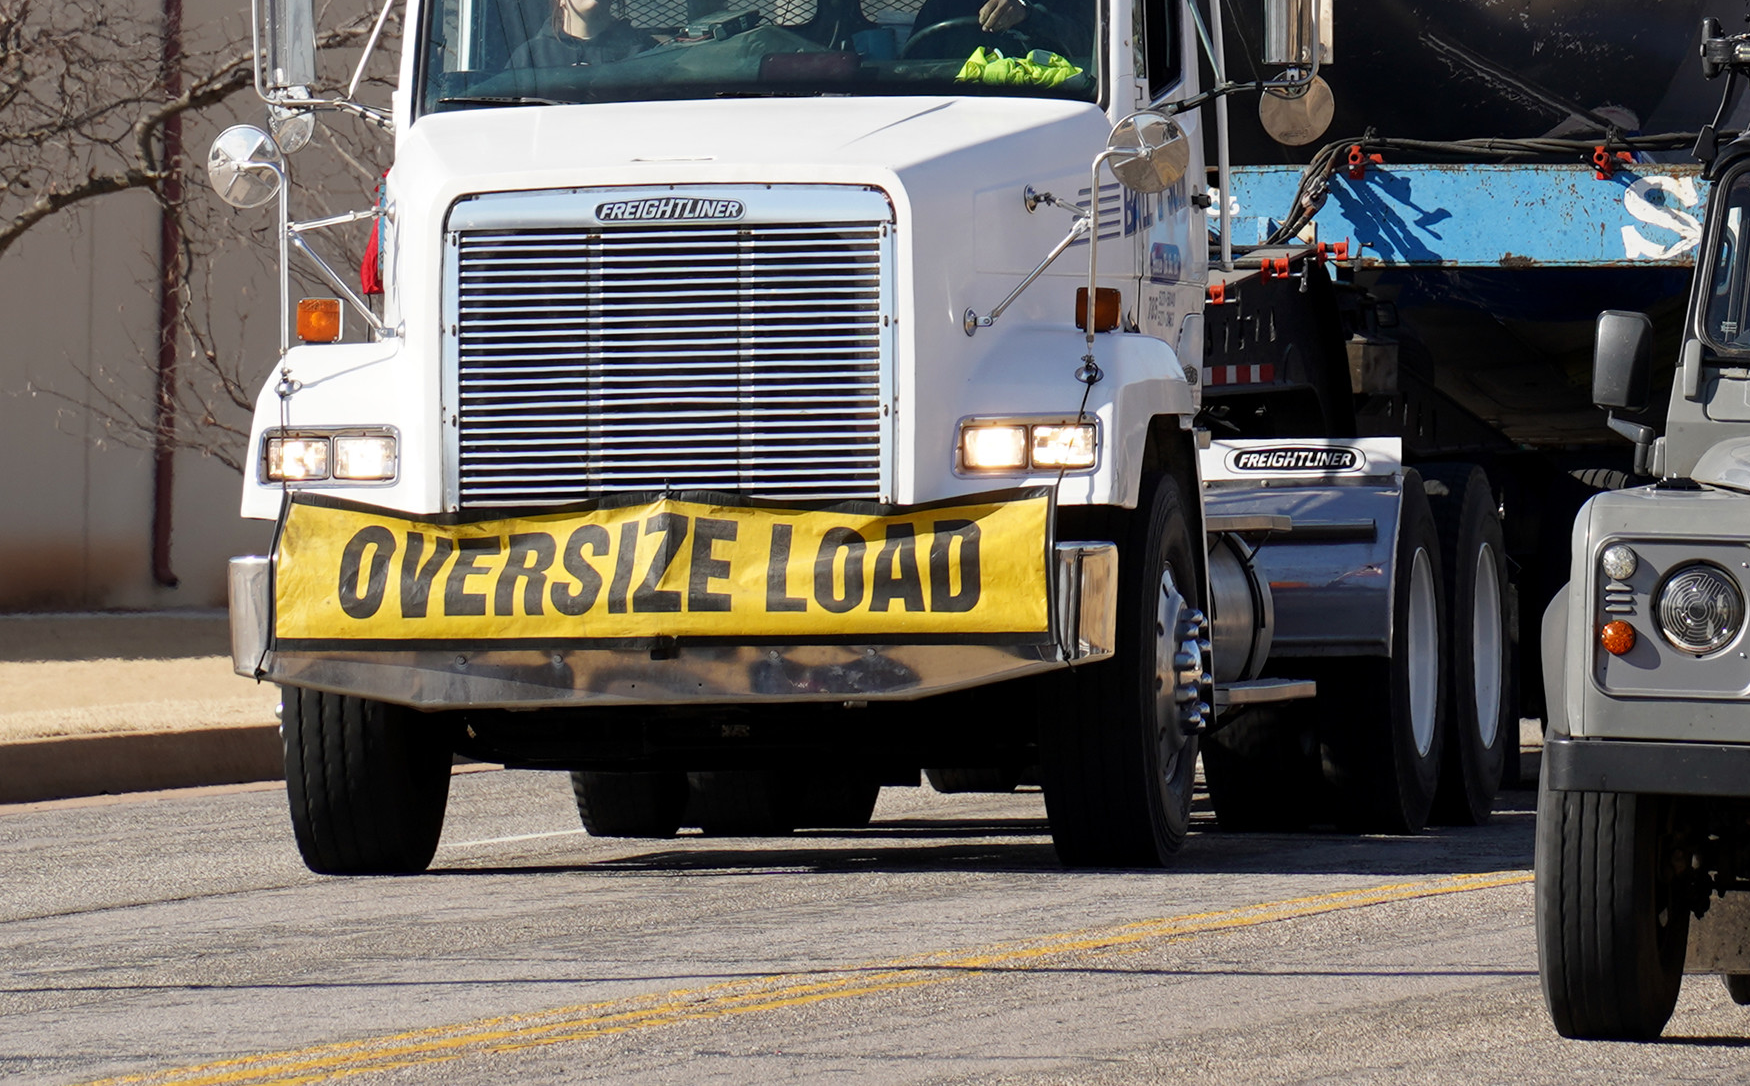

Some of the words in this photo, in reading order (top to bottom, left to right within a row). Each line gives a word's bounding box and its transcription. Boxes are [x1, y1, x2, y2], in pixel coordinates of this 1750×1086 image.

[600, 198, 740, 220] FREIGHTLINER
[1238, 451, 1352, 468] FREIGHTLINER
[338, 513, 733, 620] OVERSIZE
[766, 518, 982, 614] LOAD
